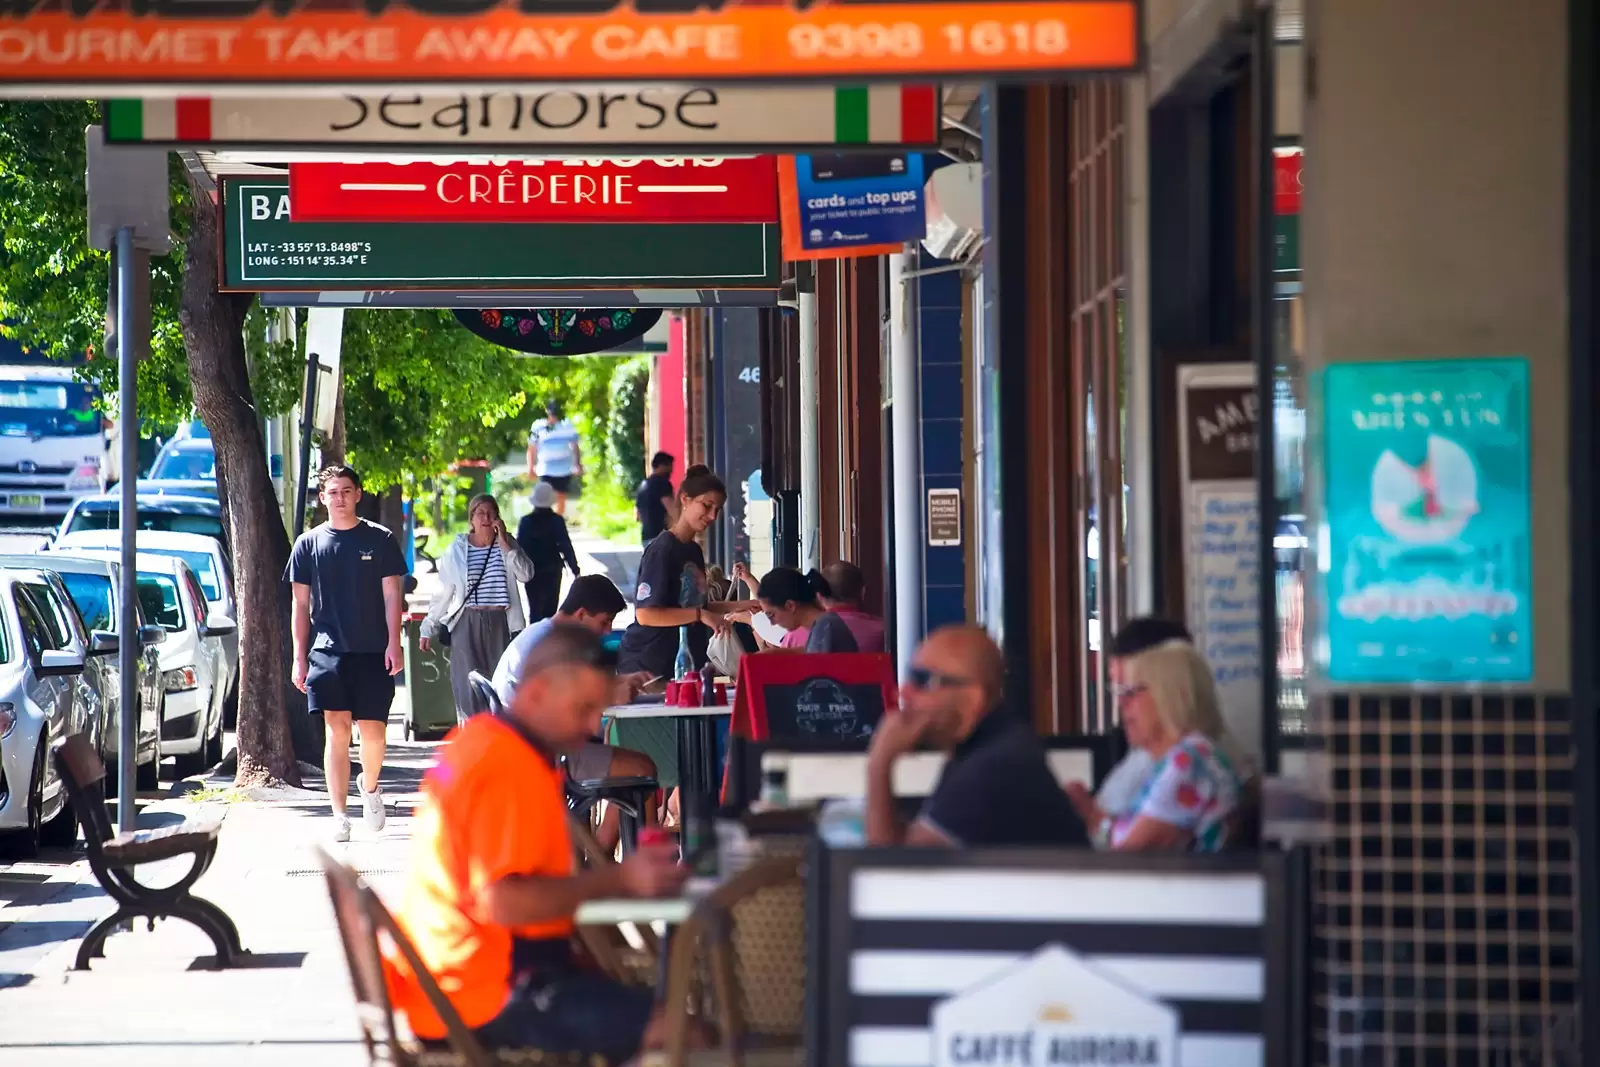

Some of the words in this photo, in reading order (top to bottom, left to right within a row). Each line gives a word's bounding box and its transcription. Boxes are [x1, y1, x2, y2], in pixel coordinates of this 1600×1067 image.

[253, 27, 398, 63] TAKE
[413, 26, 582, 62] AWAY
[591, 24, 741, 60] CAFE
[787, 22, 924, 59] 9398
[941, 20, 1069, 56] 1618
[436, 169, 633, 204] CRÊPERIE
[807, 193, 846, 209] cards
[866, 192, 889, 206] top
[891, 190, 917, 205] ups
[248, 243, 269, 253] LAT
[248, 256, 279, 266] LONG
